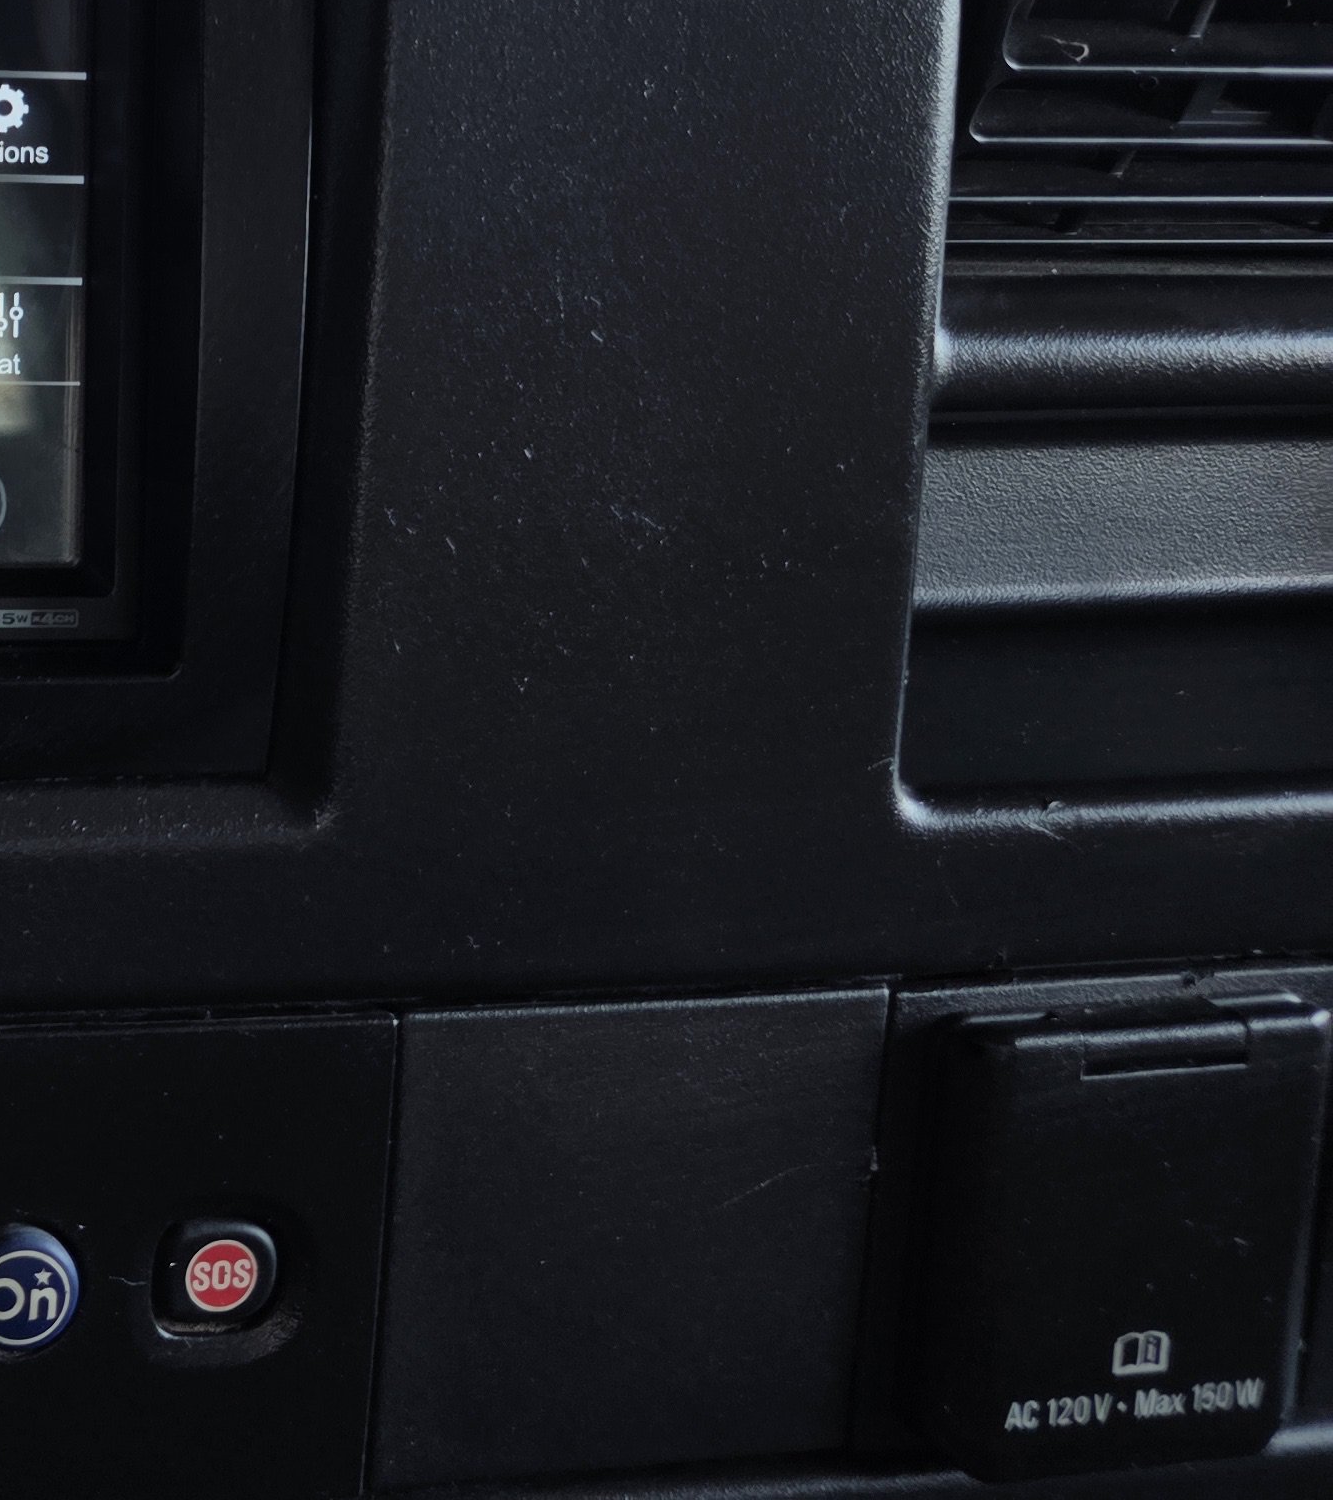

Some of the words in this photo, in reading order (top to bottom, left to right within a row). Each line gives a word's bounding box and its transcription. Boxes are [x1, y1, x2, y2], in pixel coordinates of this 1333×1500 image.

[191, 1258, 254, 1292] SOS
[1004, 1400, 1040, 1432] AC
[1134, 1388, 1186, 1418] Max
